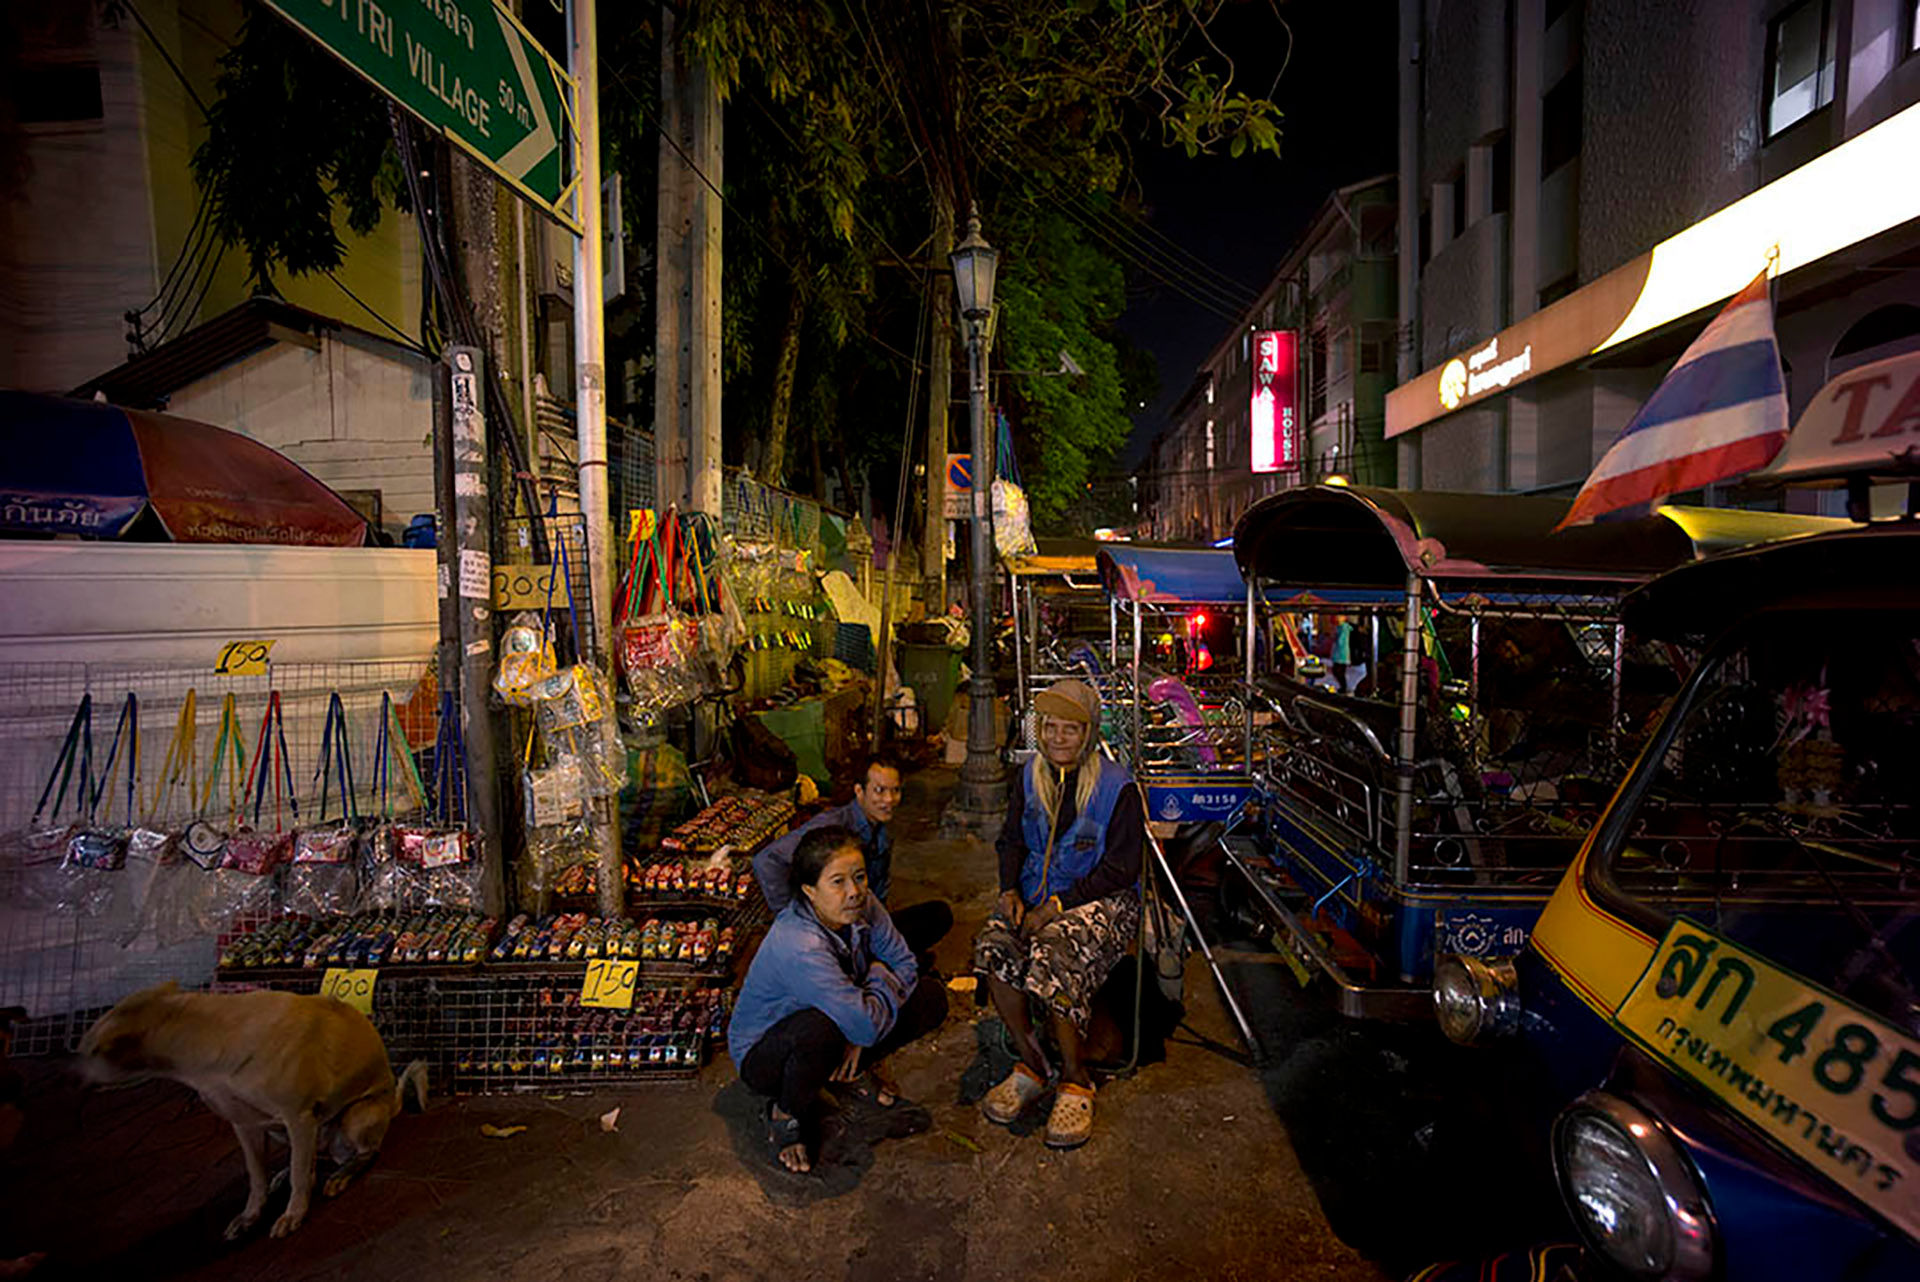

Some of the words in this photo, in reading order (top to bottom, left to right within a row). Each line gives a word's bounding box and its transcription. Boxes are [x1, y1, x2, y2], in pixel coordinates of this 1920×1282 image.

[405, 31, 490, 138] VILLAGE
[498, 79, 514, 114] 50
[493, 572, 558, 607] 300
[325, 974, 370, 999] 100
[583, 962, 636, 1002] 150
[1656, 934, 1756, 1027] สก
[1768, 1001, 1920, 1132] 485
[1656, 1018, 1902, 1192] กรุงเทพมหานคร
